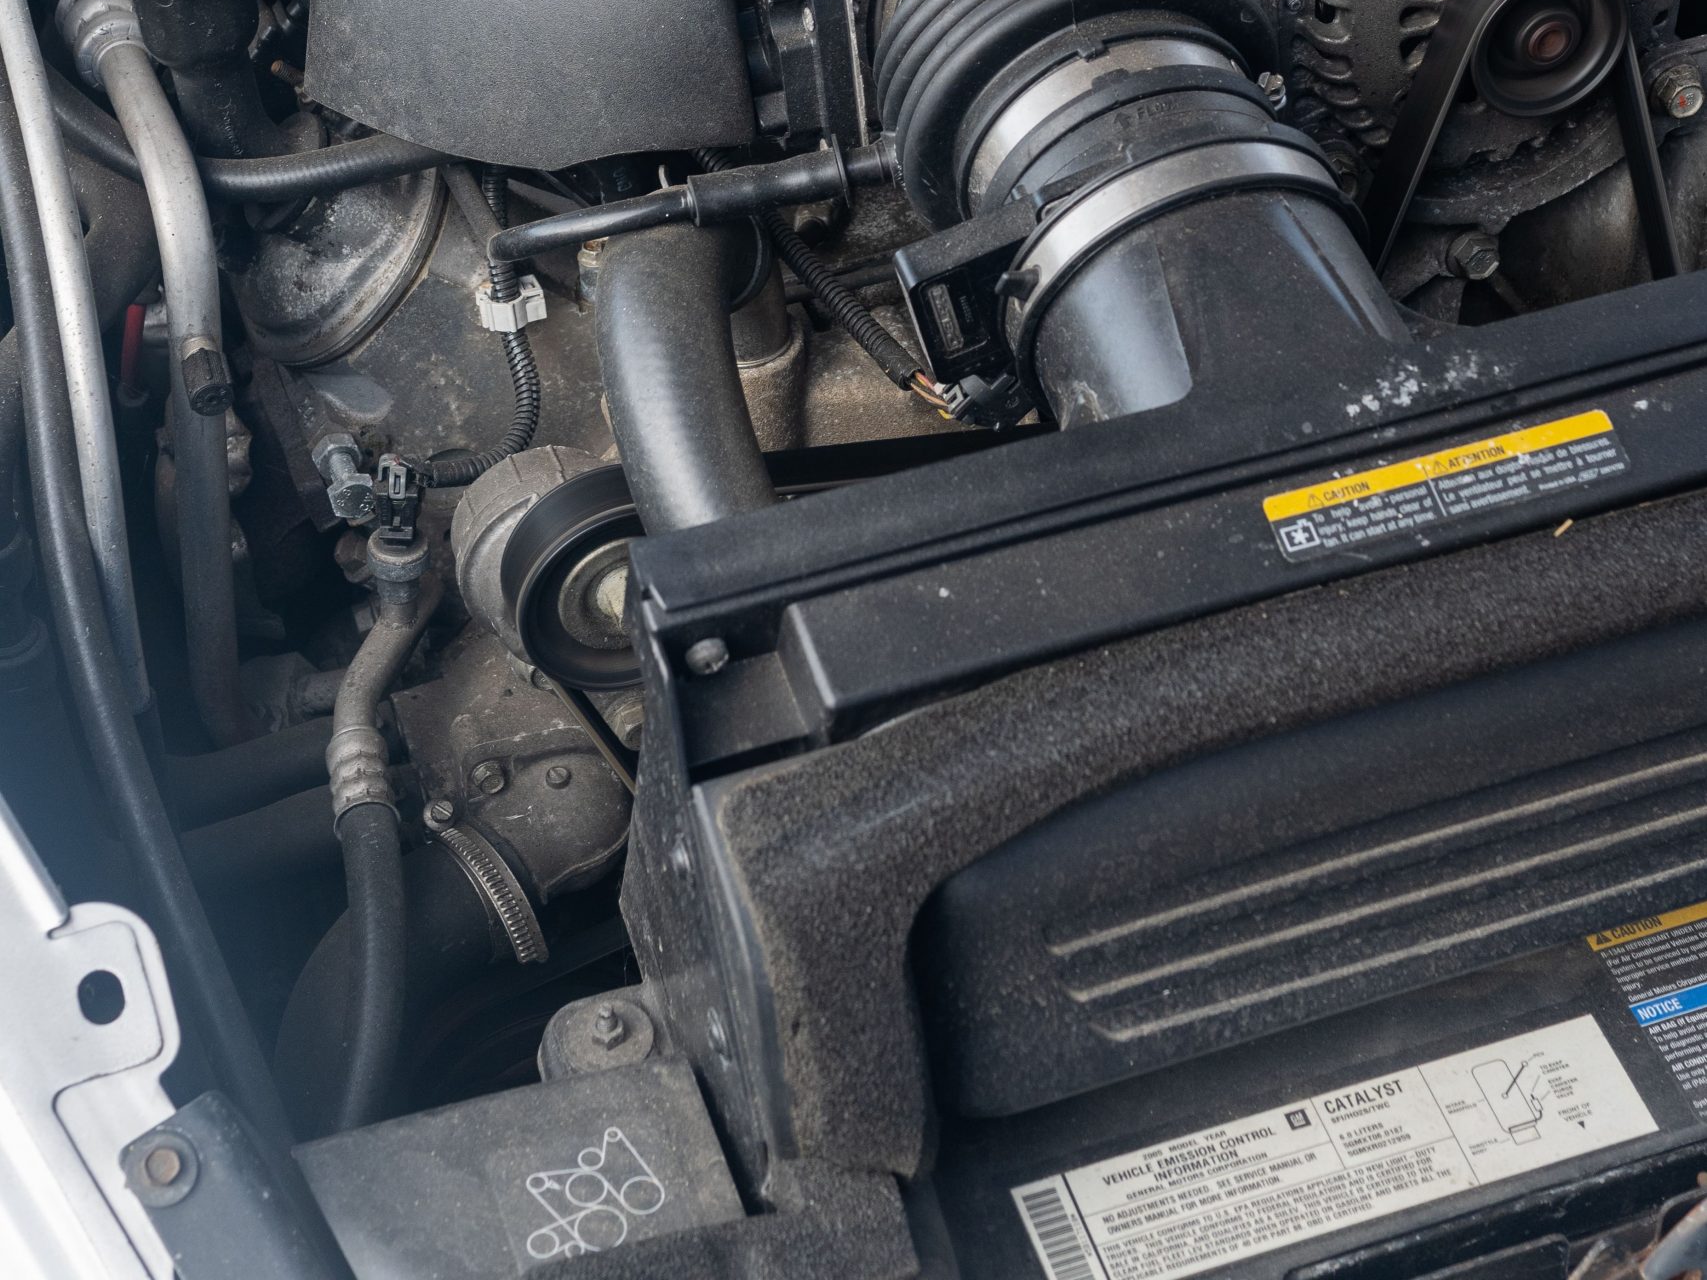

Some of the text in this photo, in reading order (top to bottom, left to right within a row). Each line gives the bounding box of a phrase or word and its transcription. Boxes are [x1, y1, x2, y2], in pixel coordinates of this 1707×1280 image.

[1323, 482, 1370, 502] CAUTION
[1611, 916, 1662, 939] CAUTION
[1637, 998, 1683, 1020] NOTICE
[1324, 1080, 1403, 1114] CATALYST
[1102, 1127, 1274, 1186] VEHICLE EMISSION CONTROL
[1154, 1149, 1238, 1182] INFORMATION
[1117, 1196, 1176, 1220] ADJUSTMENTS
[1234, 1168, 1266, 1183] SERVICE
[1269, 1158, 1302, 1172] MANUAL
[1144, 1208, 1177, 1222] MANUAL
